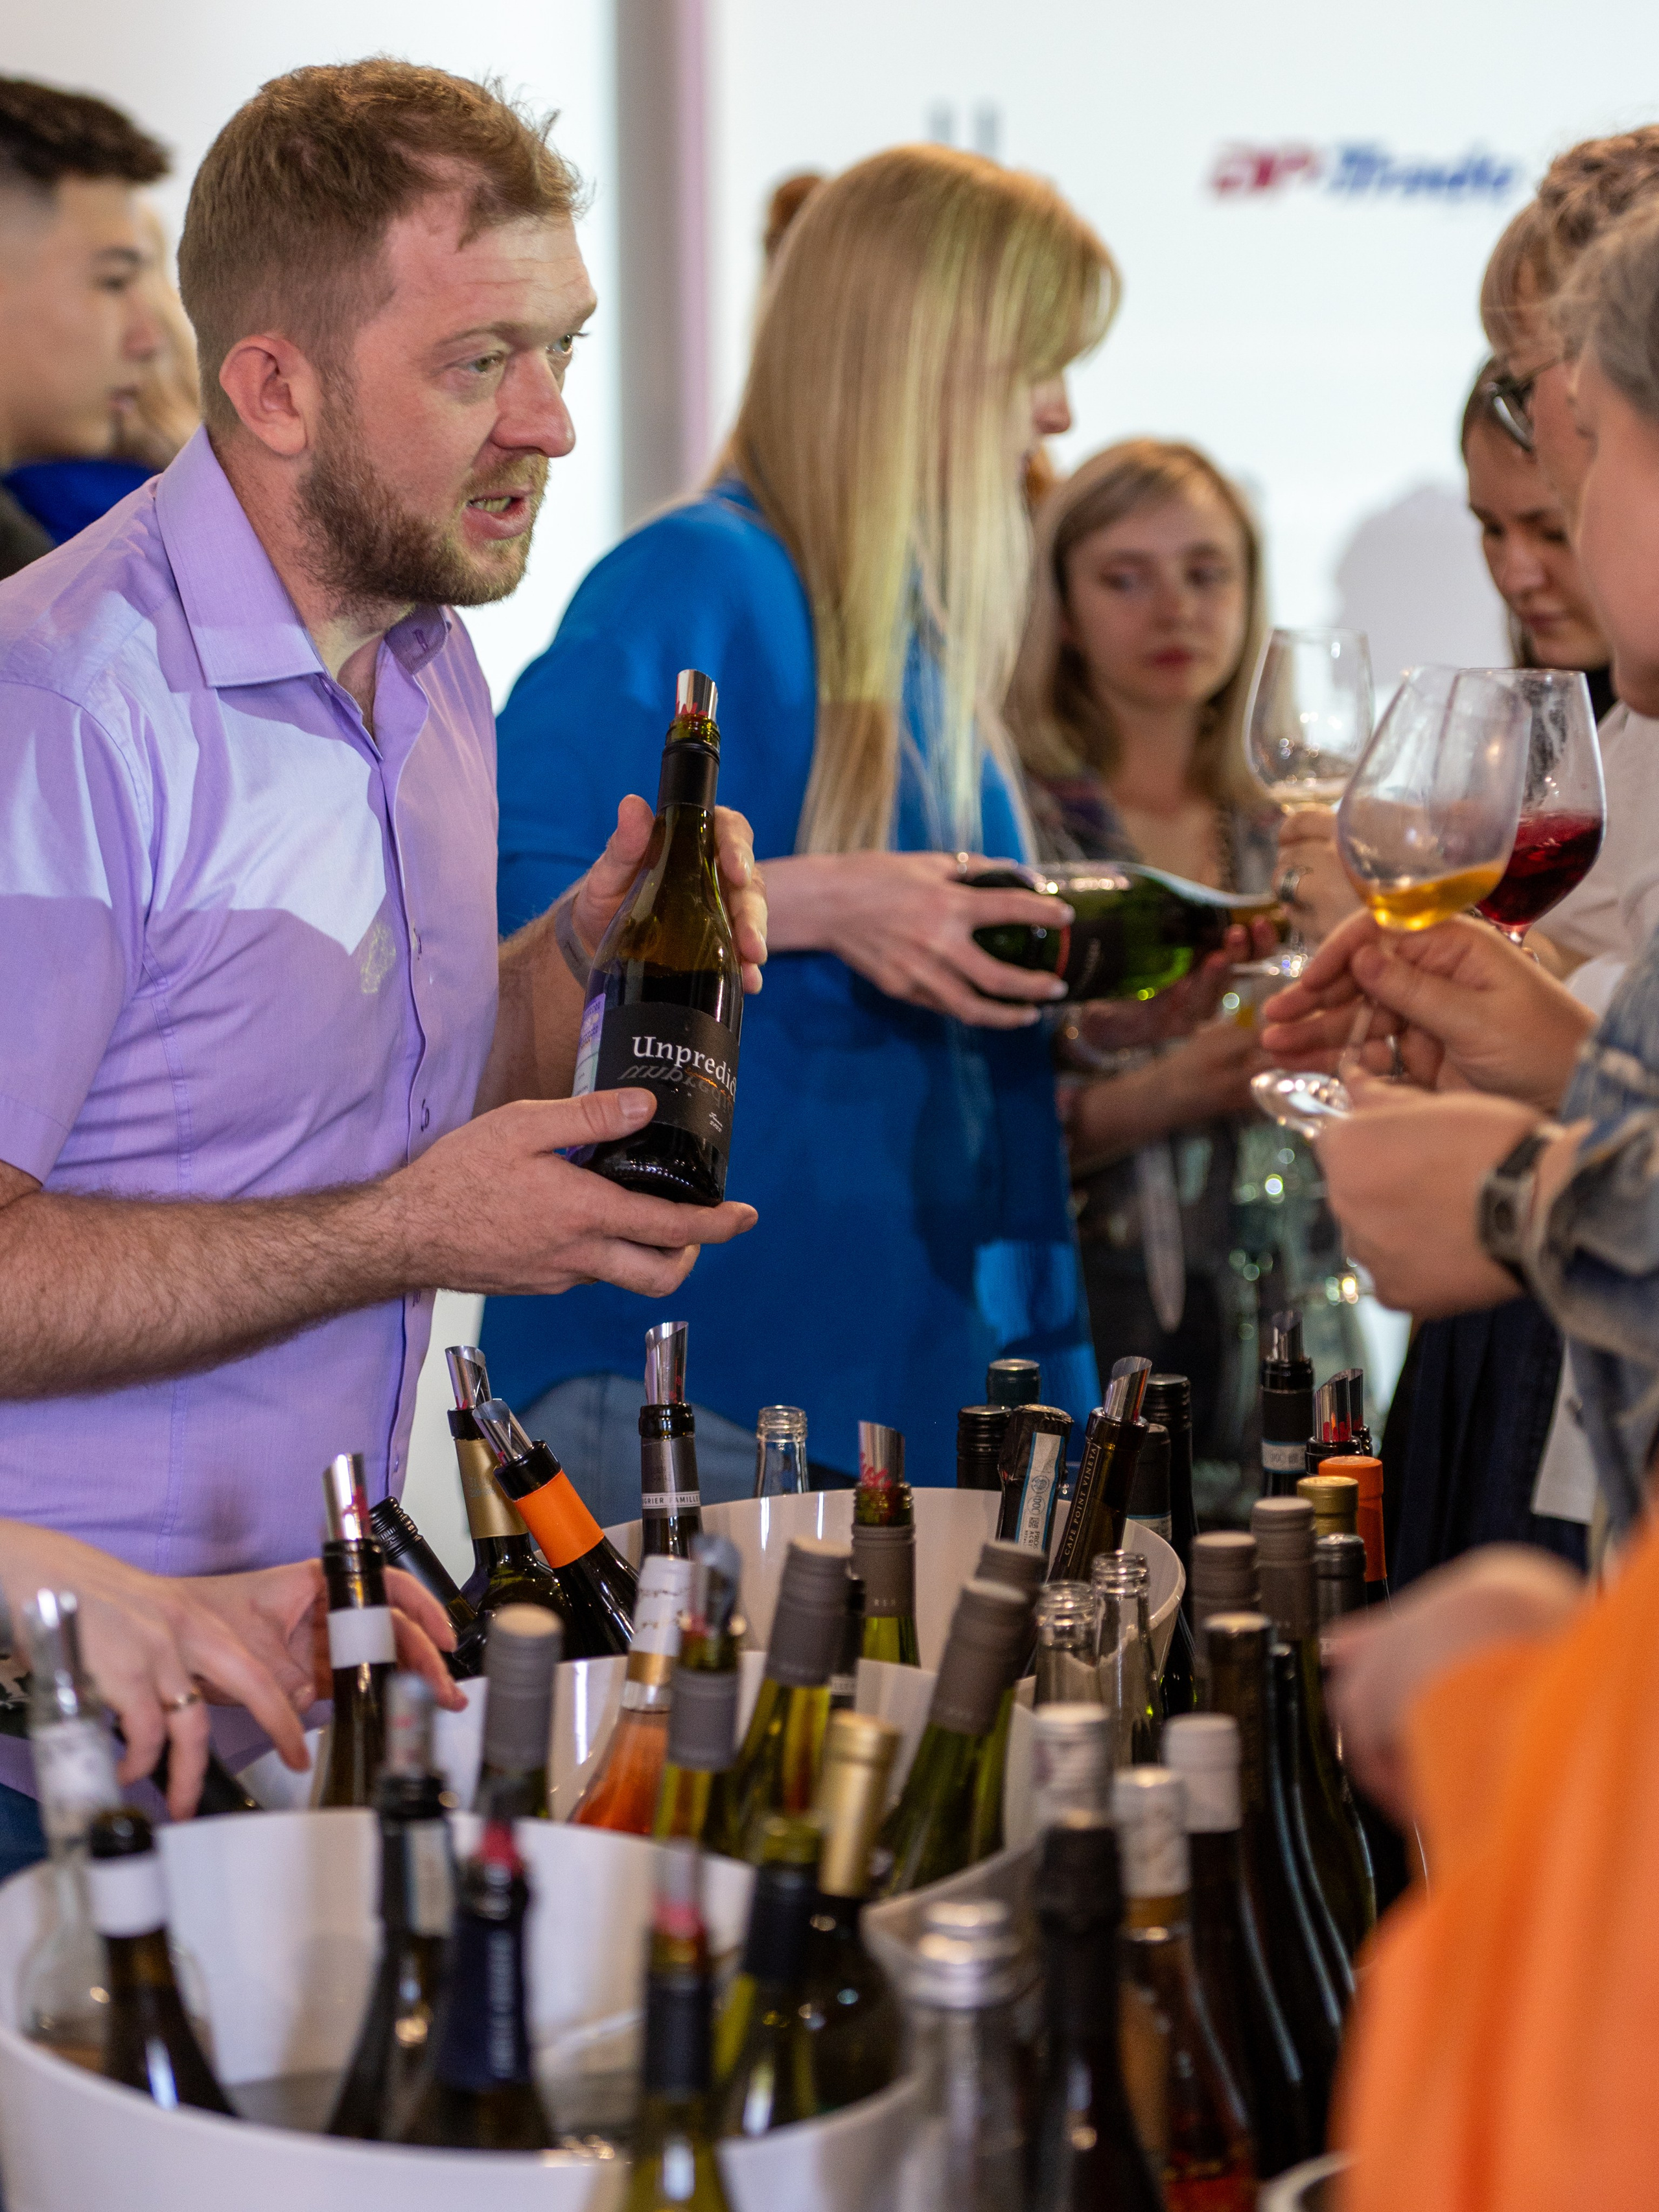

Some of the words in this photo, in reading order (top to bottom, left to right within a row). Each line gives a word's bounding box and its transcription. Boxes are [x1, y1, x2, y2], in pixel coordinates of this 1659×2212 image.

[1032, 1496, 1041, 1514] DOC
[1065, 1529, 1076, 1555] CAPE
[1074, 1491, 1086, 1524] POINT
